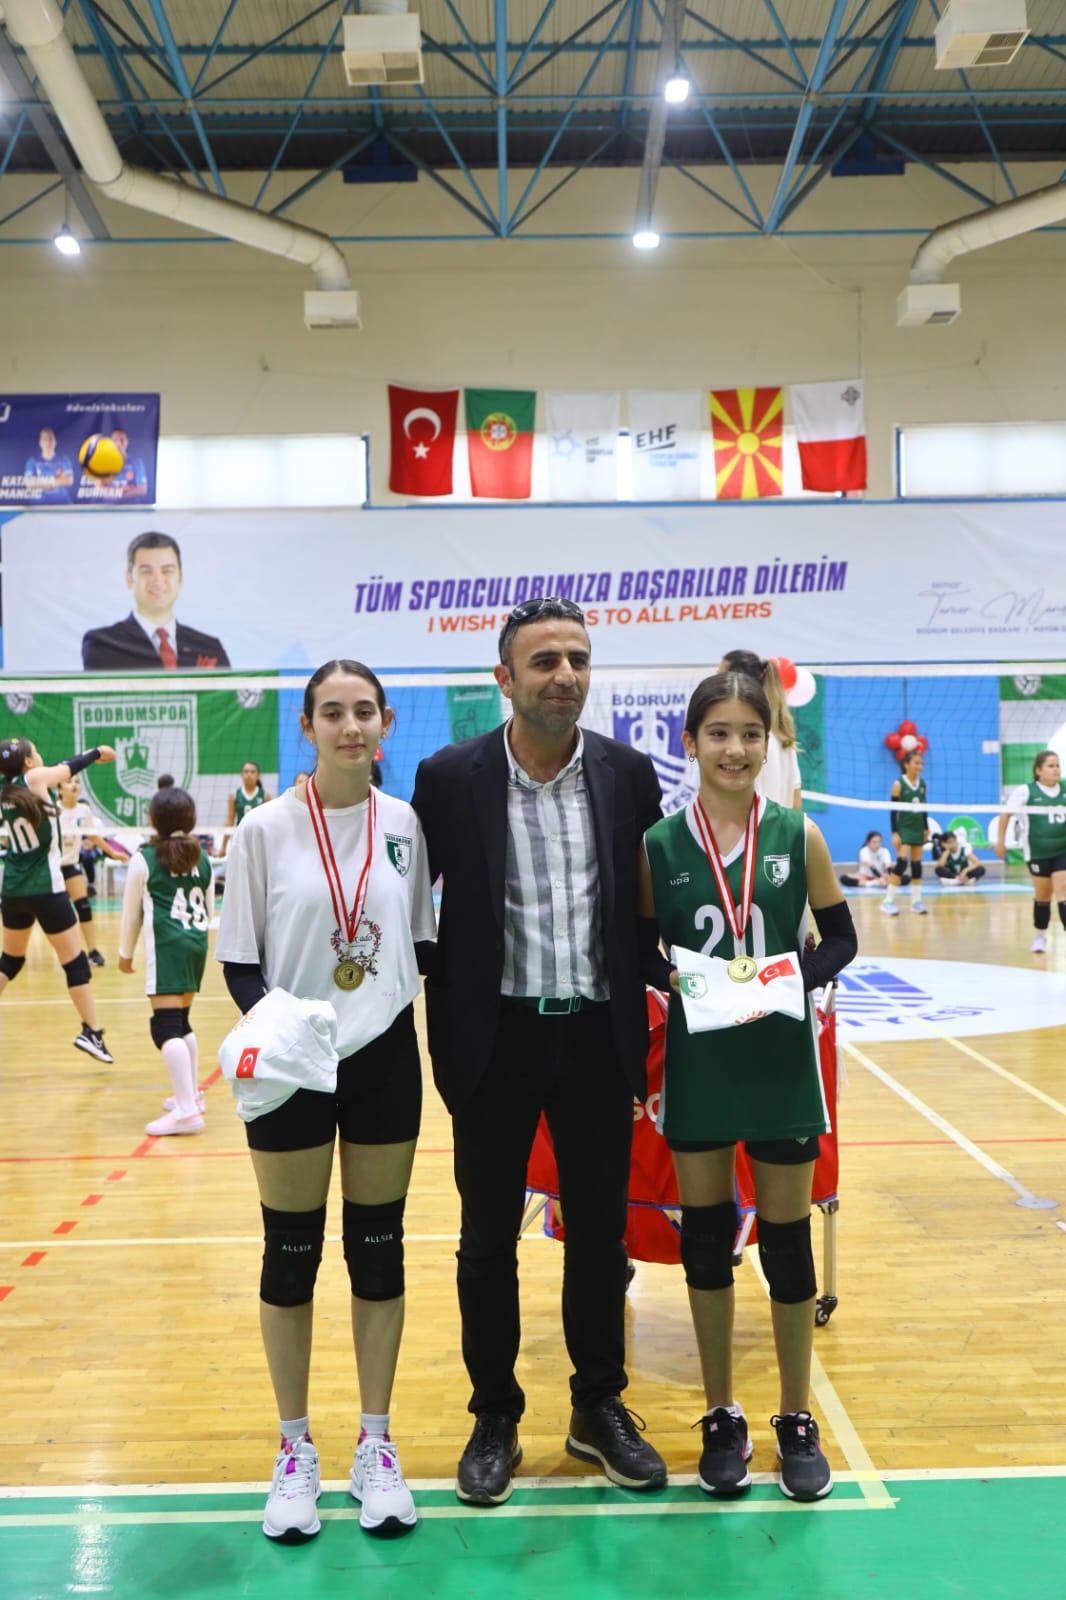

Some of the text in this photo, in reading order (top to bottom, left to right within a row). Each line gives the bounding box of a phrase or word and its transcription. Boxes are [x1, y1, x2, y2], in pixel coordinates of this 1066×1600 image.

[636, 424, 677, 448] EHF
[355, 555, 848, 613] TÜM SPORCULARIMIZA BAŞARILAR DİLERİM
[428, 616, 434, 632] I
[439, 614, 496, 632] WISH
[604, 607, 632, 625] TO
[636, 606, 674, 623] ALL
[678, 601, 772, 621] PLAYERS
[84, 704, 187, 722] BODRUMSPOR
[612, 694, 686, 706] BODRUM
[4, 817, 40, 853] 10
[170, 886, 208, 932] 48
[694, 902, 766, 959] 20
[281, 1244, 313, 1252] ALLSIX
[364, 1233, 394, 1243] ALLSIX
